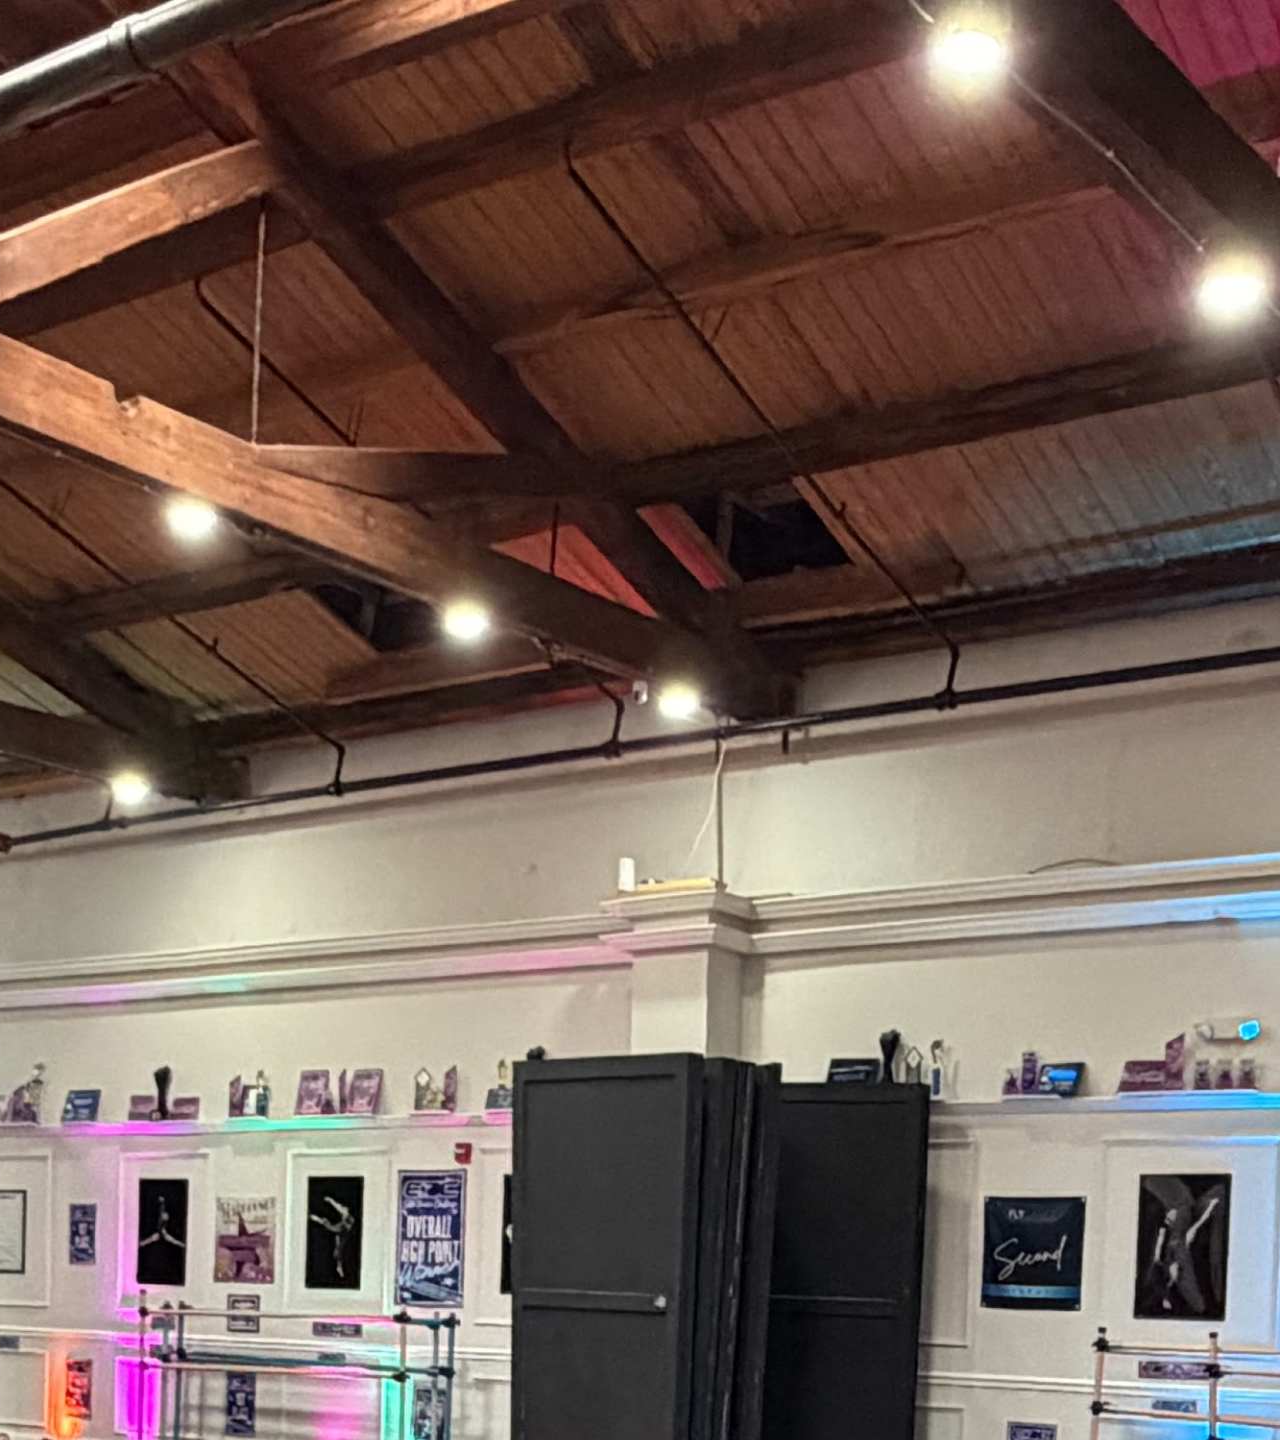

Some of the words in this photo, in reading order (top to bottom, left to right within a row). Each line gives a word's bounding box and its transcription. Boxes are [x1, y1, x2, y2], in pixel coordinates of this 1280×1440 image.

[406, 1215, 452, 1239] OVERALL
[428, 1240, 459, 1264] POINT
[994, 1234, 1067, 1281] Second
